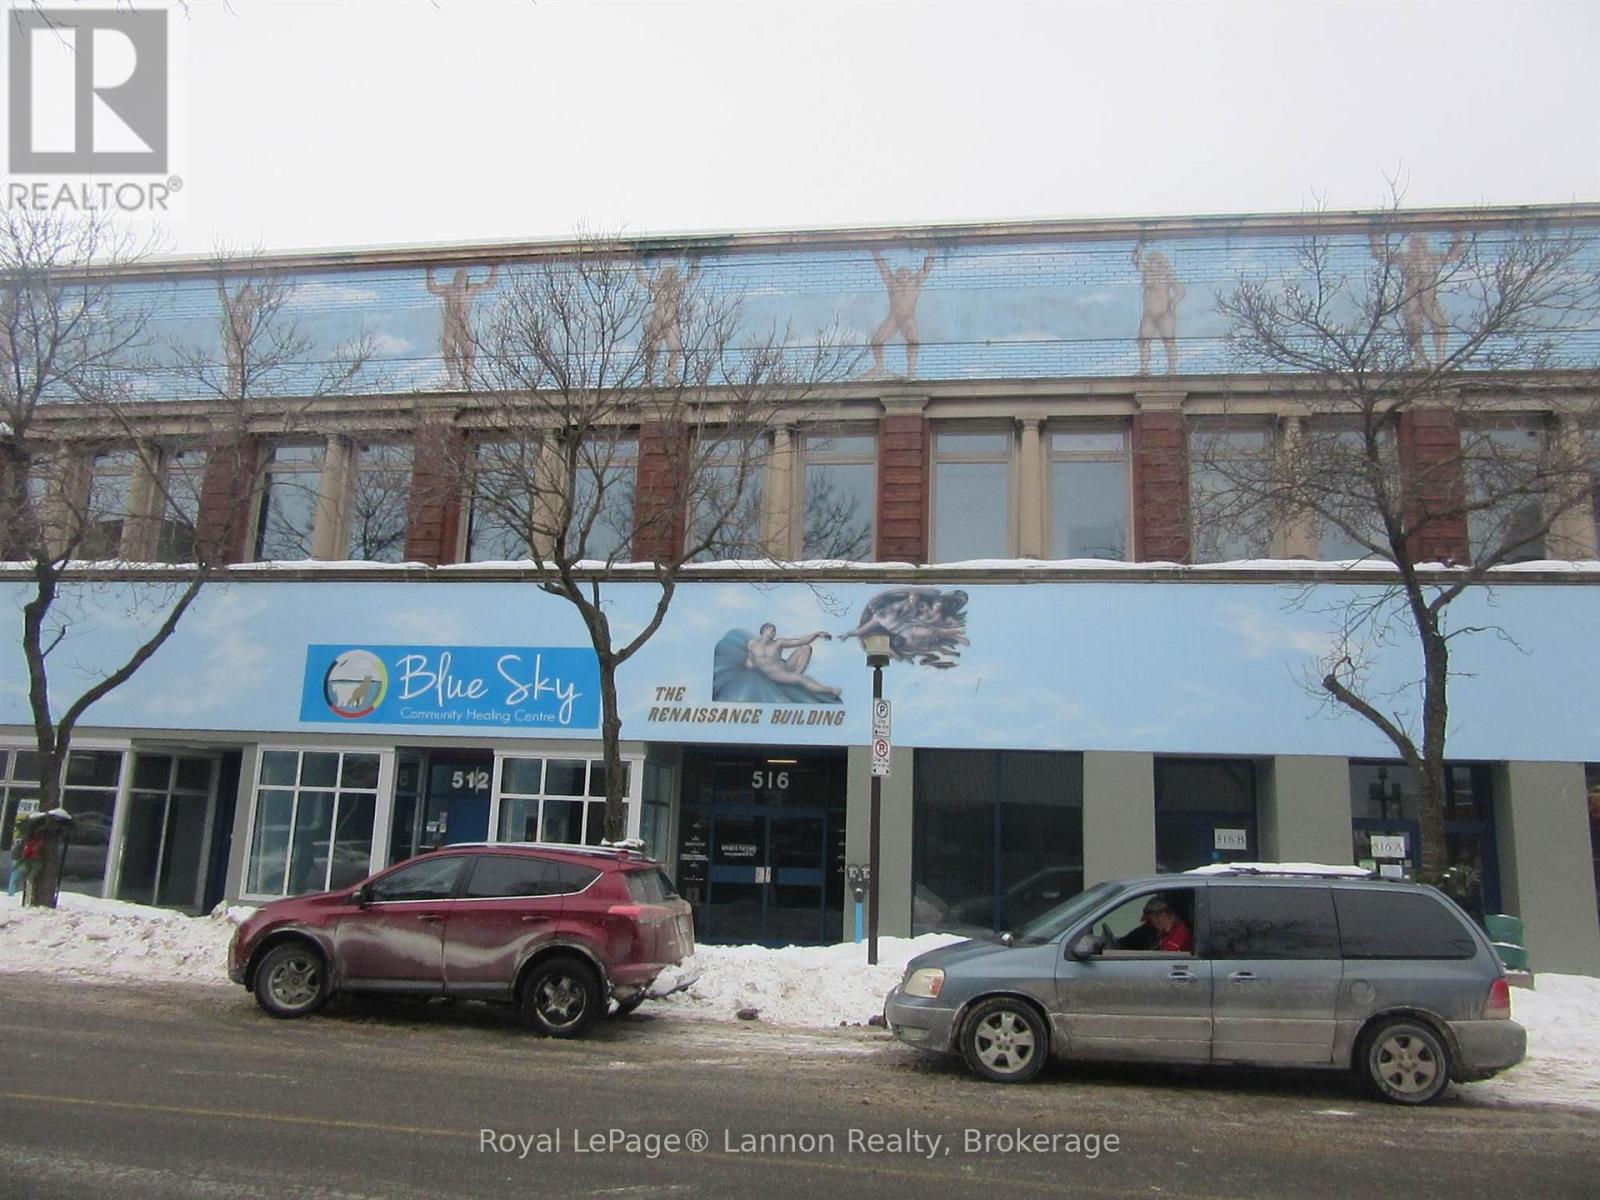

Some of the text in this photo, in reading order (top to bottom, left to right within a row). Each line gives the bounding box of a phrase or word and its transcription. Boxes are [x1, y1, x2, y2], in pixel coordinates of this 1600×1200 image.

[396, 651, 583, 724] Blue Sky
[655, 687, 687, 701] THE
[400, 707, 556, 724] Community Healing Centre
[648, 707, 846, 725] RENAISSANCE BUILDING
[751, 770, 790, 790] 516
[1237, 833, 1245, 845] B
